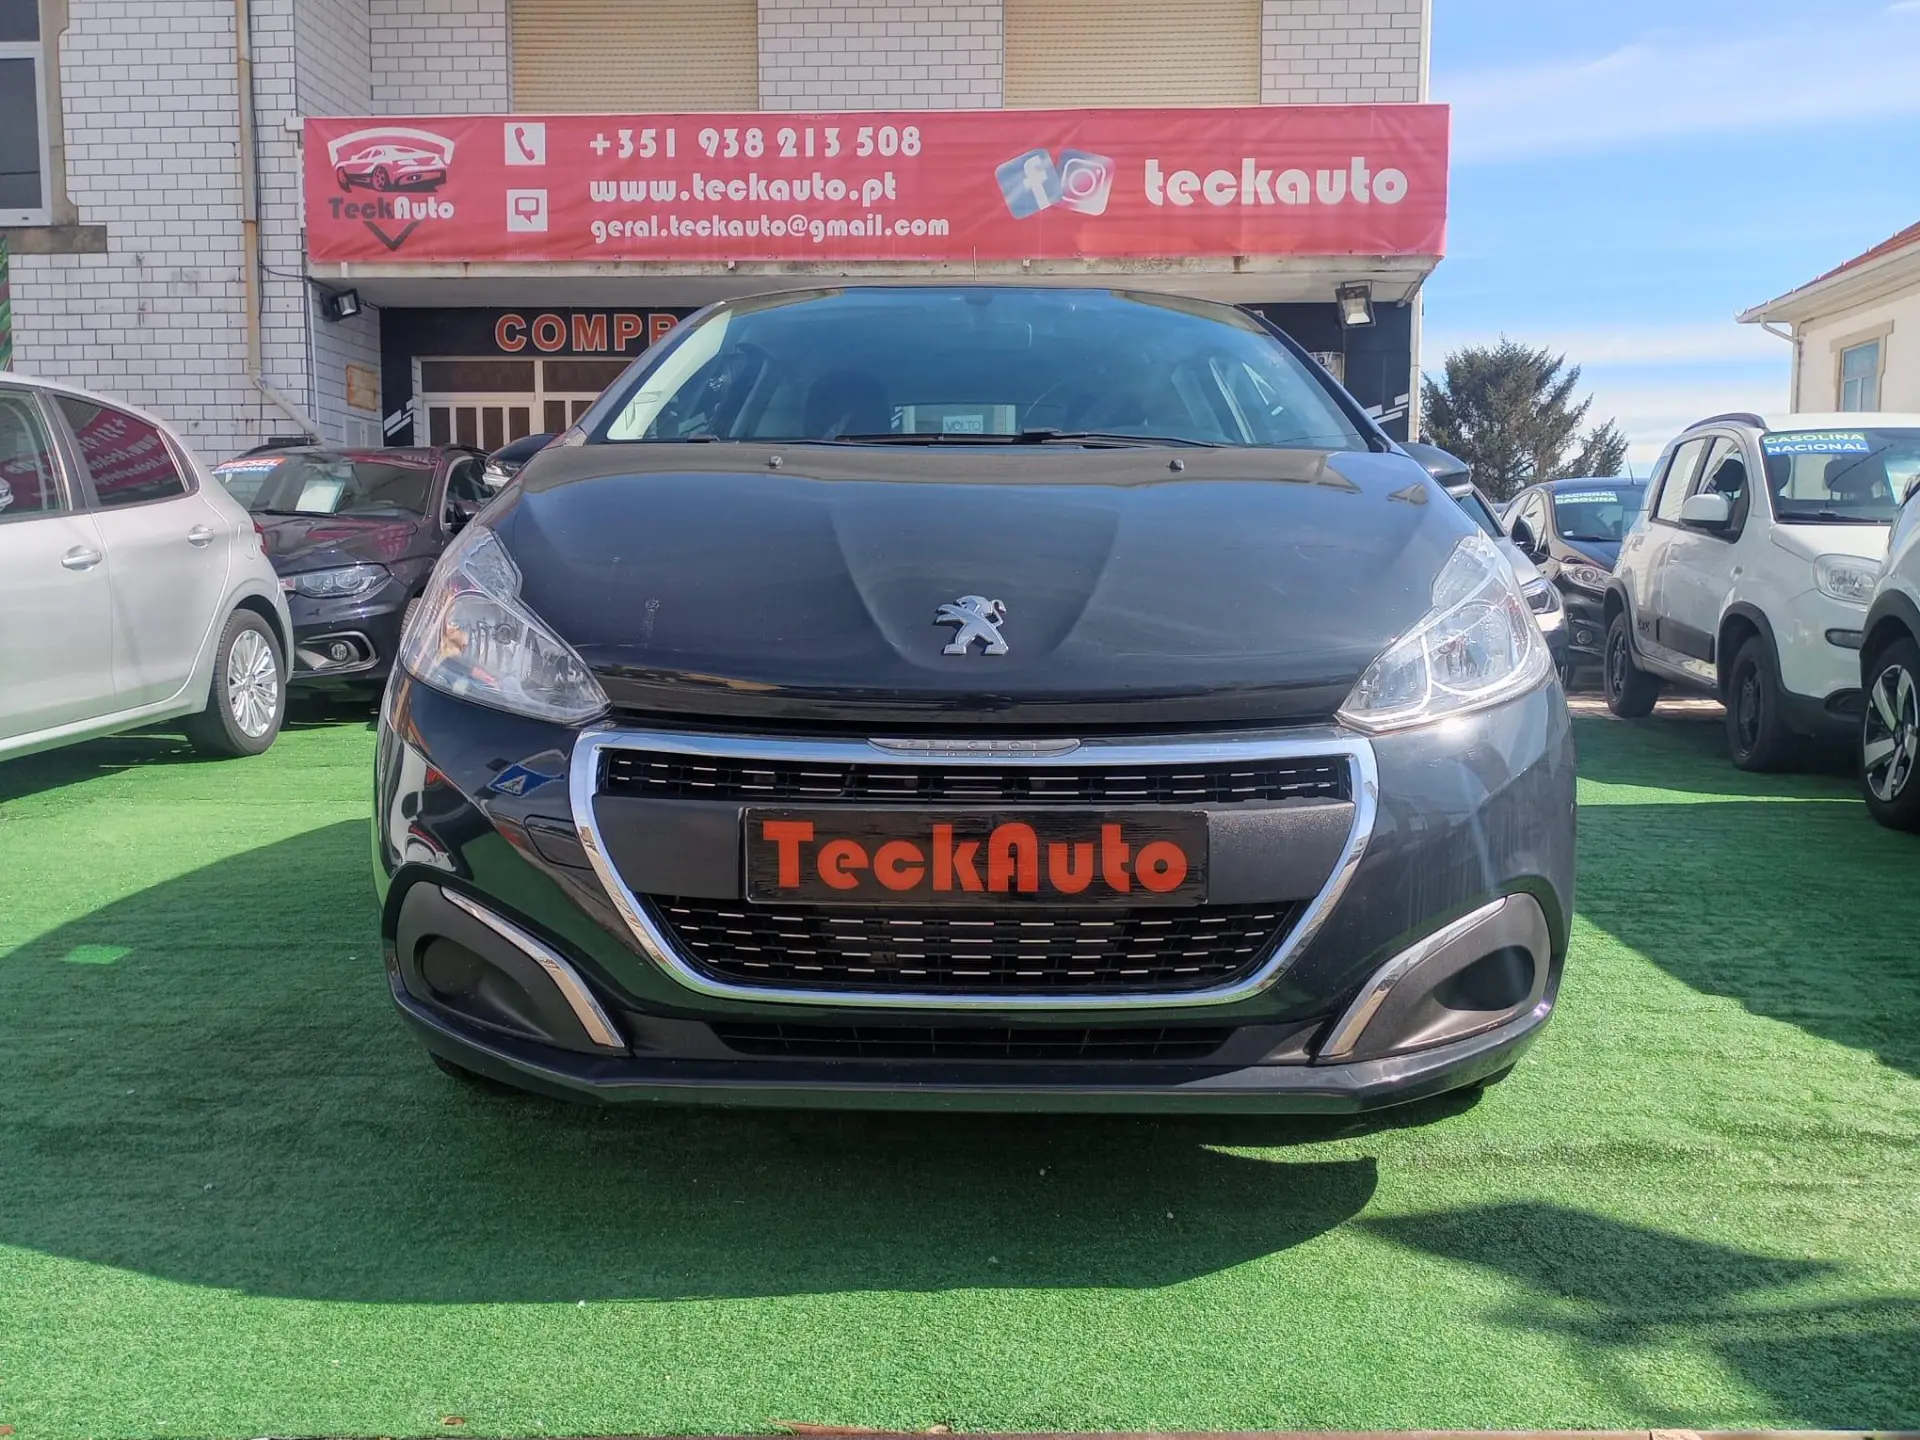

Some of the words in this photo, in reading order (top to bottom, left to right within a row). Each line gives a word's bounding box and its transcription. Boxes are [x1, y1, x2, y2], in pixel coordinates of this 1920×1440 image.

[589, 128, 676, 158] +351
[698, 127, 765, 158] 938
[777, 127, 840, 158] 213
[856, 126, 921, 156] 508
[589, 171, 896, 207] www.teckauto.pt
[1144, 156, 1408, 206] teckauto
[328, 196, 455, 220] TeckAuto
[590, 213, 949, 244] geral.teckauto@gmail.com
[945, 420, 980, 432] VOLTO
[1764, 433, 1865, 444] GASOLINA
[1767, 442, 1868, 453] NACIONAL
[762, 820, 1189, 894] TeckAuto
